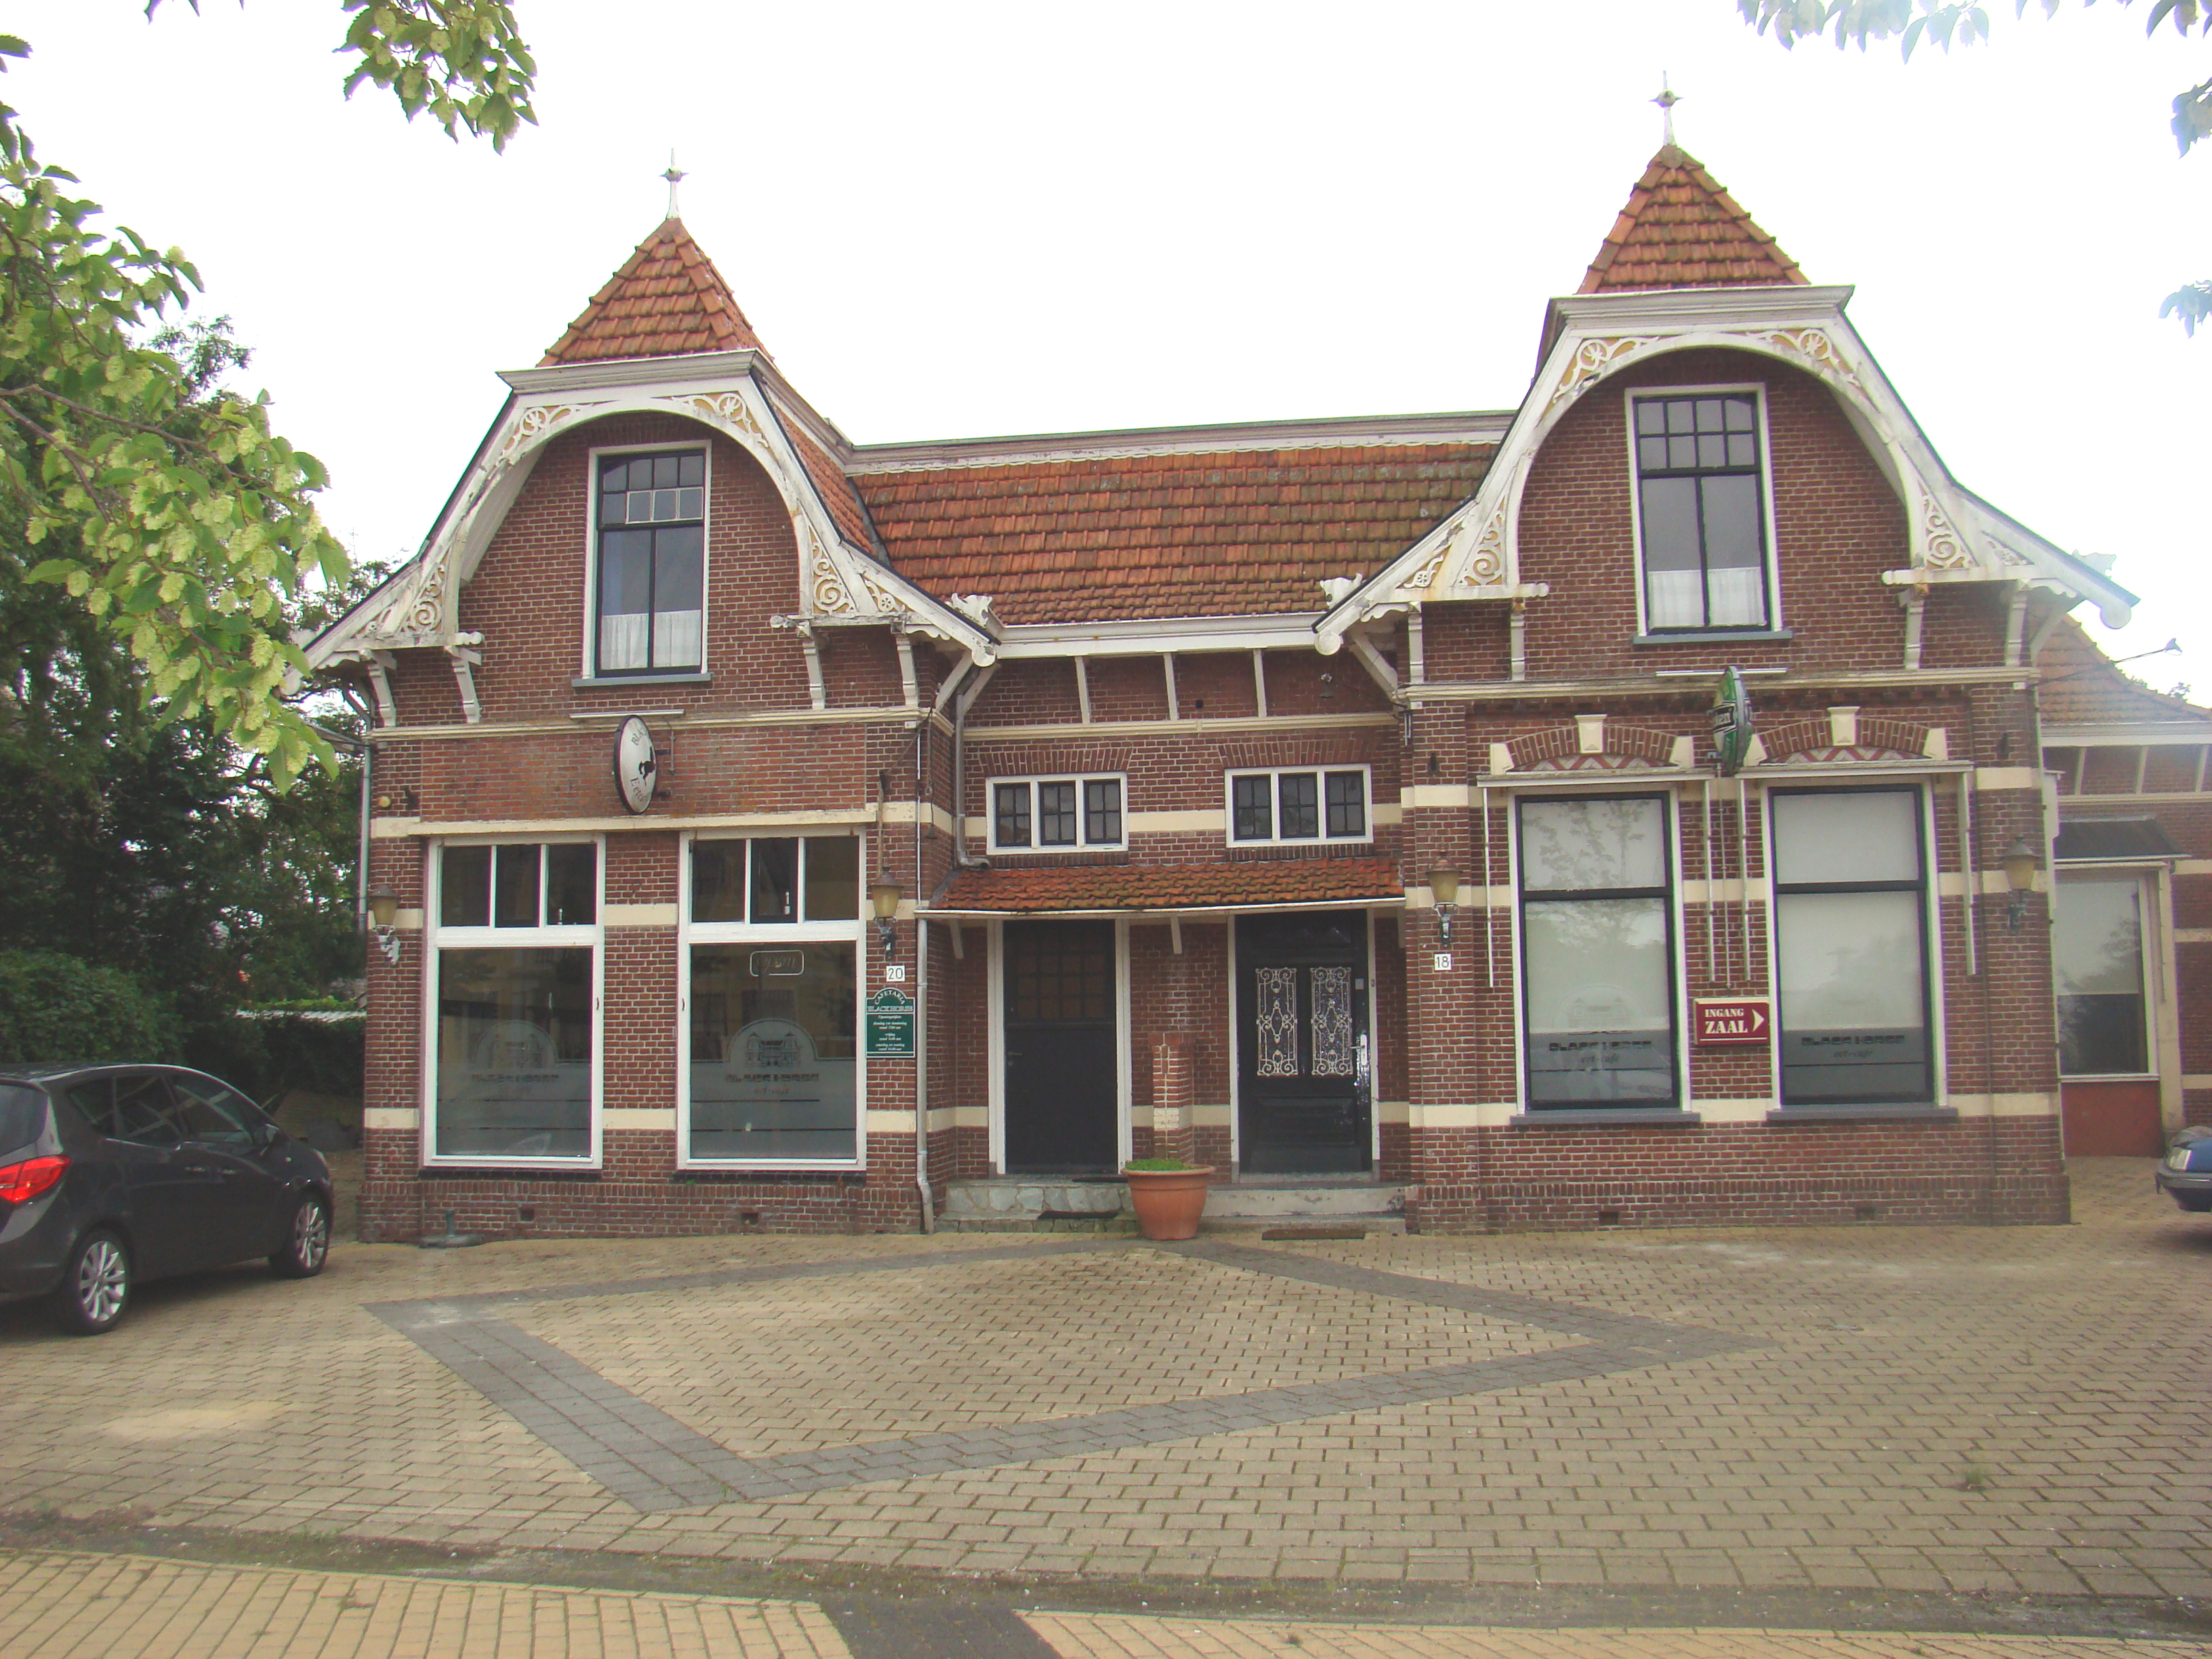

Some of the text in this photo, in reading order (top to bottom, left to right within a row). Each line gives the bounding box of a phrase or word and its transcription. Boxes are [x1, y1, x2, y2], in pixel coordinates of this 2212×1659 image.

[1436, 956, 1449, 968] 18
[888, 968, 903, 979] 20
[875, 990, 905, 1004] CAFETARIA
[1705, 1008, 1744, 1017] INGANG
[1705, 1020, 1748, 1034] ZAAL
